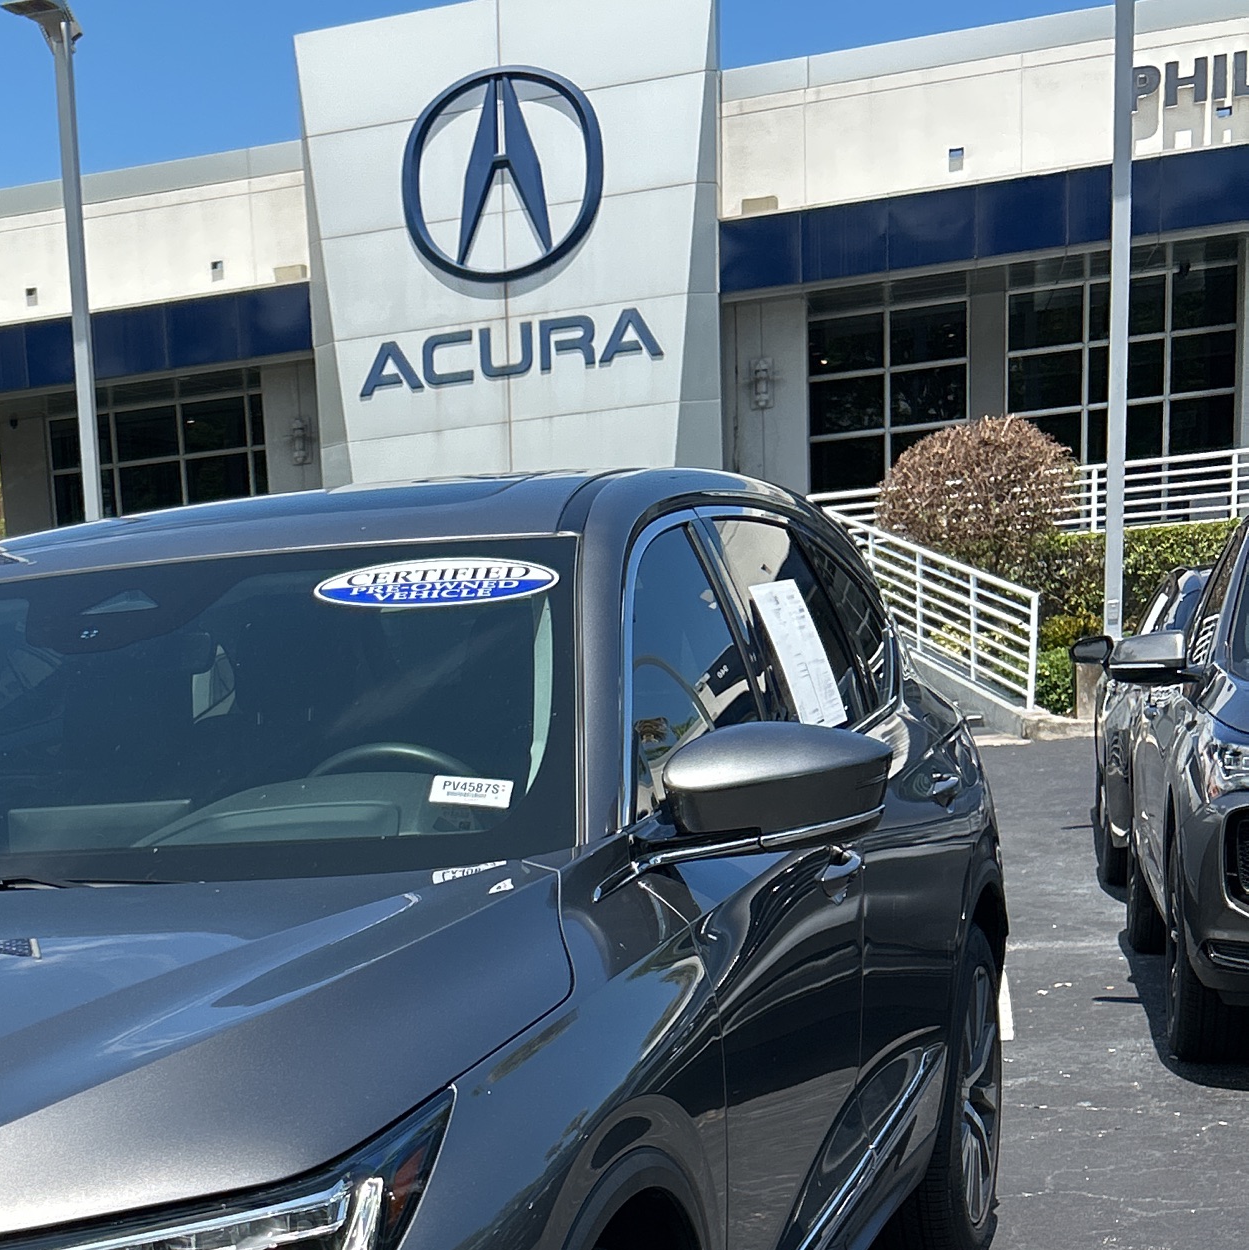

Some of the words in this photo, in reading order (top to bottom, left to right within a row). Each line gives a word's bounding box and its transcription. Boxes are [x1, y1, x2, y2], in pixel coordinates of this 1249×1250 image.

[1132, 50, 1249, 112] PHIL
[360, 307, 664, 400] ACURA
[346, 566, 531, 588] CERTIFIED
[350, 580, 519, 596] PRE-OWNED
[374, 587, 493, 601] VEHICLE
[442, 780, 501, 795] PV4587S
